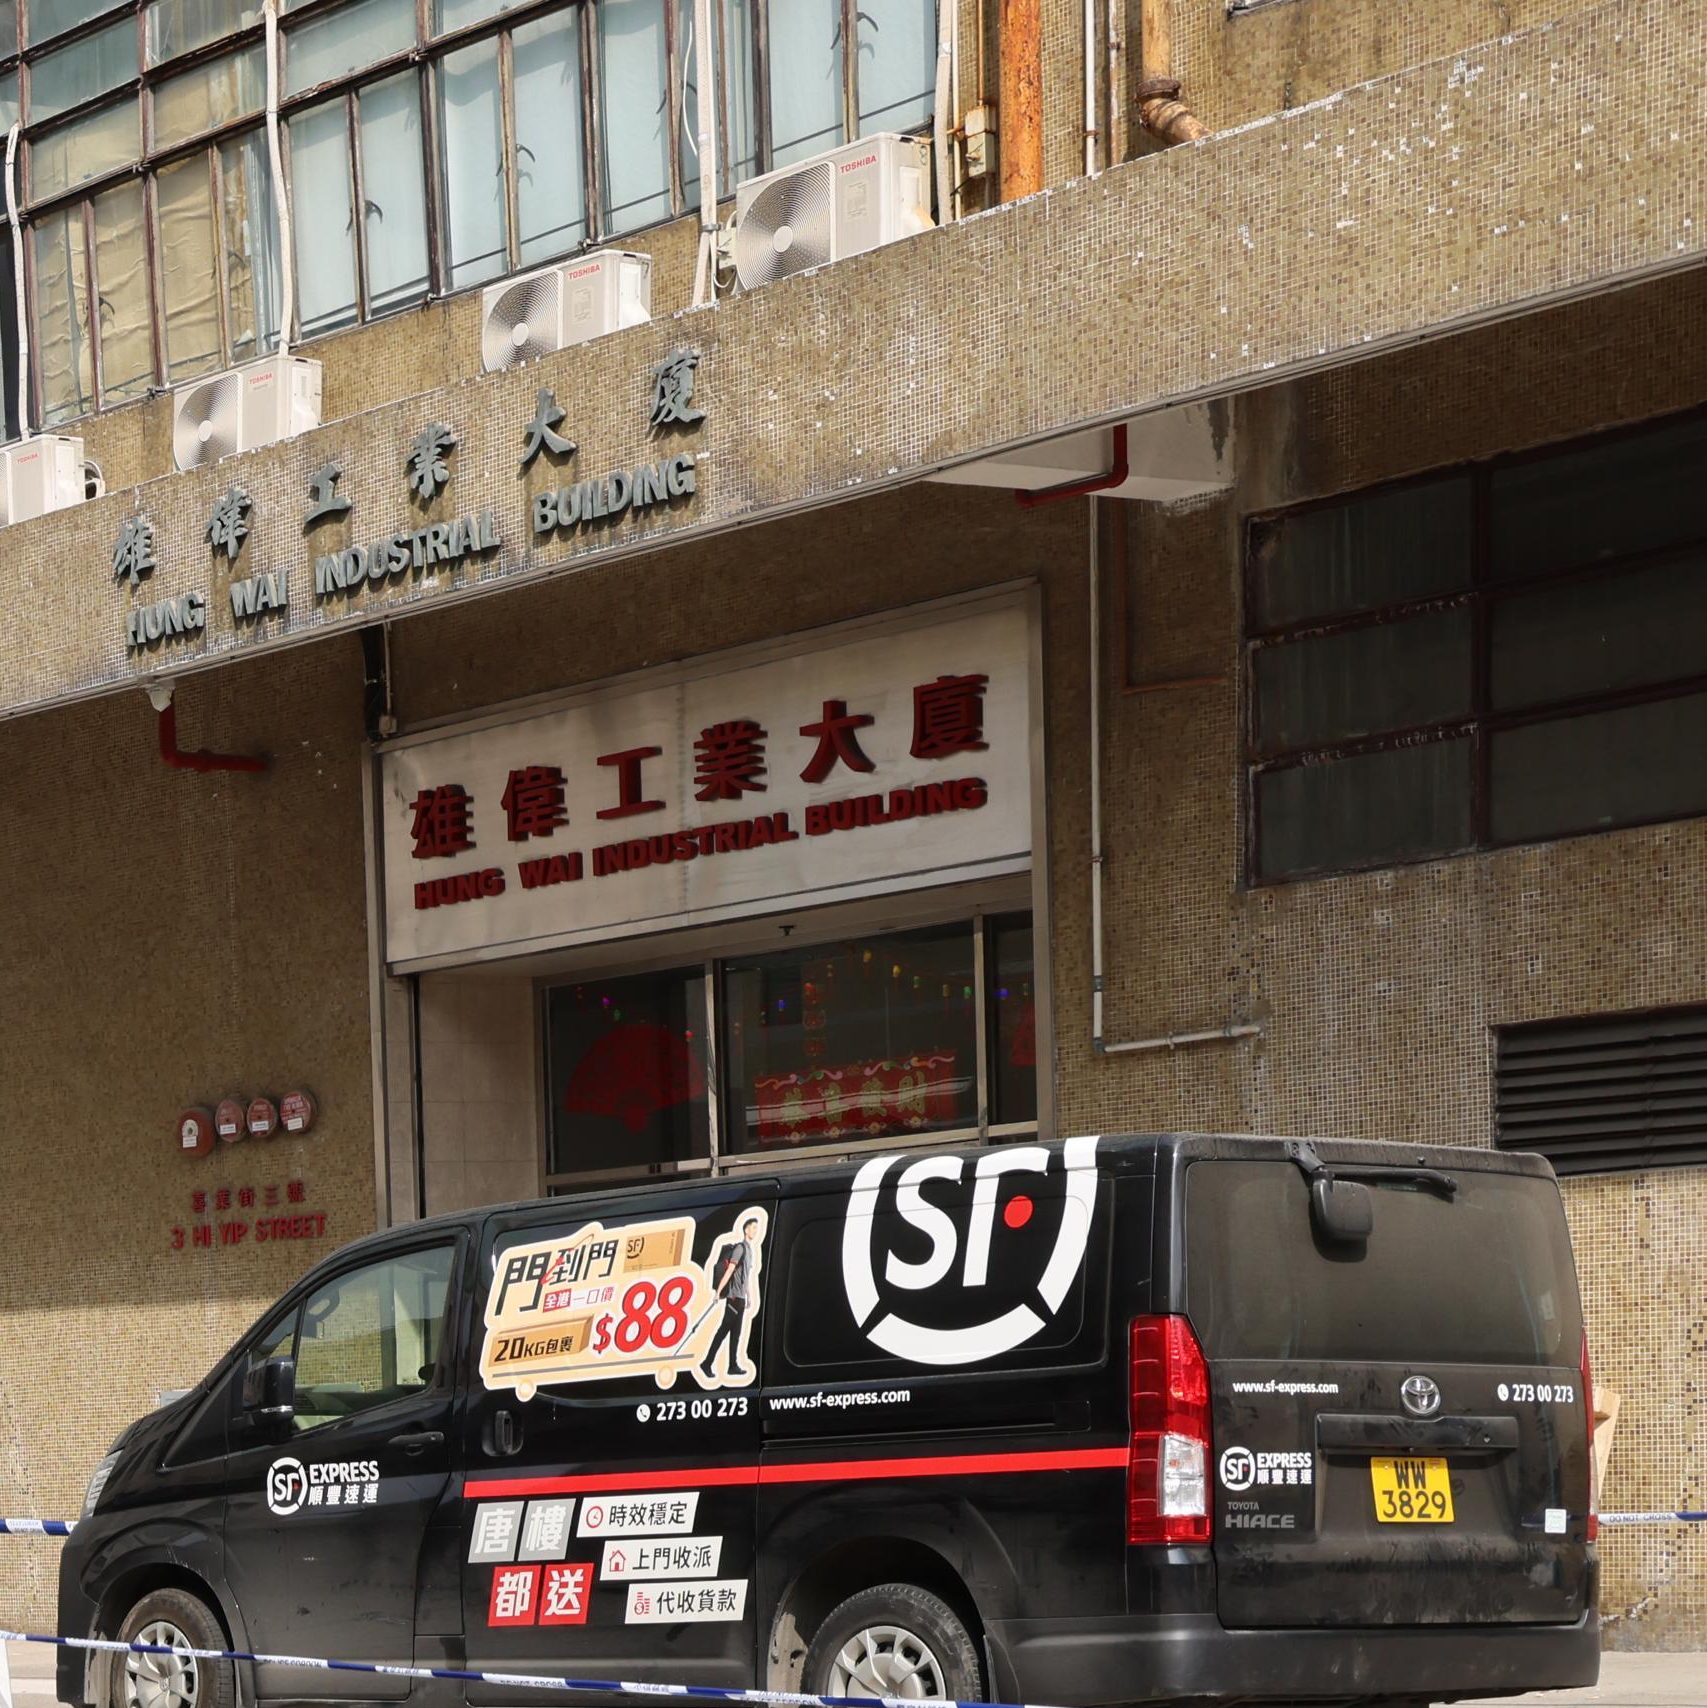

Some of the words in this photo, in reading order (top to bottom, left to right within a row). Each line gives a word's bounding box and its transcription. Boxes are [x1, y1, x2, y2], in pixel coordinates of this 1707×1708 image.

[840, 155, 876, 173] TOSHIBA
[569, 264, 601, 279] TOSHIBA
[112, 348, 706, 586] 雄偉工業大廈
[127, 592, 205, 646] HUNG
[230, 568, 288, 618] WAI
[315, 510, 501, 596] INDUSTRIAL
[534, 453, 696, 533] BUILDING
[410, 674, 989, 859] 雄偉工業大廈
[414, 867, 506, 910] HUNG
[518, 851, 583, 889] WAI
[592, 812, 799, 876] INDUSTRIAL
[804, 776, 988, 836] BUILDING
[170, 1226, 185, 1249] 3
[192, 1223, 212, 1248] HI
[218, 1221, 248, 1245] YIP
[255, 1213, 328, 1243] STREET
[494, 1239, 620, 1317] 門到門
[593, 1276, 694, 1355] $88
[494, 1336, 574, 1363] 20KG包裹
[1233, 1380, 1339, 1395] www.sf-express.com
[1512, 1383, 1535, 1402] 273
[1537, 1384, 1554, 1402] 00
[1554, 1385, 1574, 1403] 273
[656, 1402, 686, 1421] 273
[691, 1399, 712, 1418] 00
[717, 1397, 748, 1416] 273
[769, 1389, 911, 1411] www.sf-express.com
[309, 1460, 380, 1484] EXPRESS
[1256, 1452, 1312, 1468] EXPRESS
[1395, 1461, 1427, 1489] WW
[308, 1483, 379, 1506] 順豐速運
[1227, 1501, 1259, 1511] TOYOTA
[1382, 1490, 1447, 1519] 3829
[609, 1501, 687, 1528] 時效穩定
[1225, 1514, 1295, 1528] HIACE
[475, 1504, 566, 1554] 唐樓
[632, 1544, 712, 1571] 上門收派
[496, 1569, 585, 1618] 都送
[656, 1590, 737, 1616] 代收貨款
